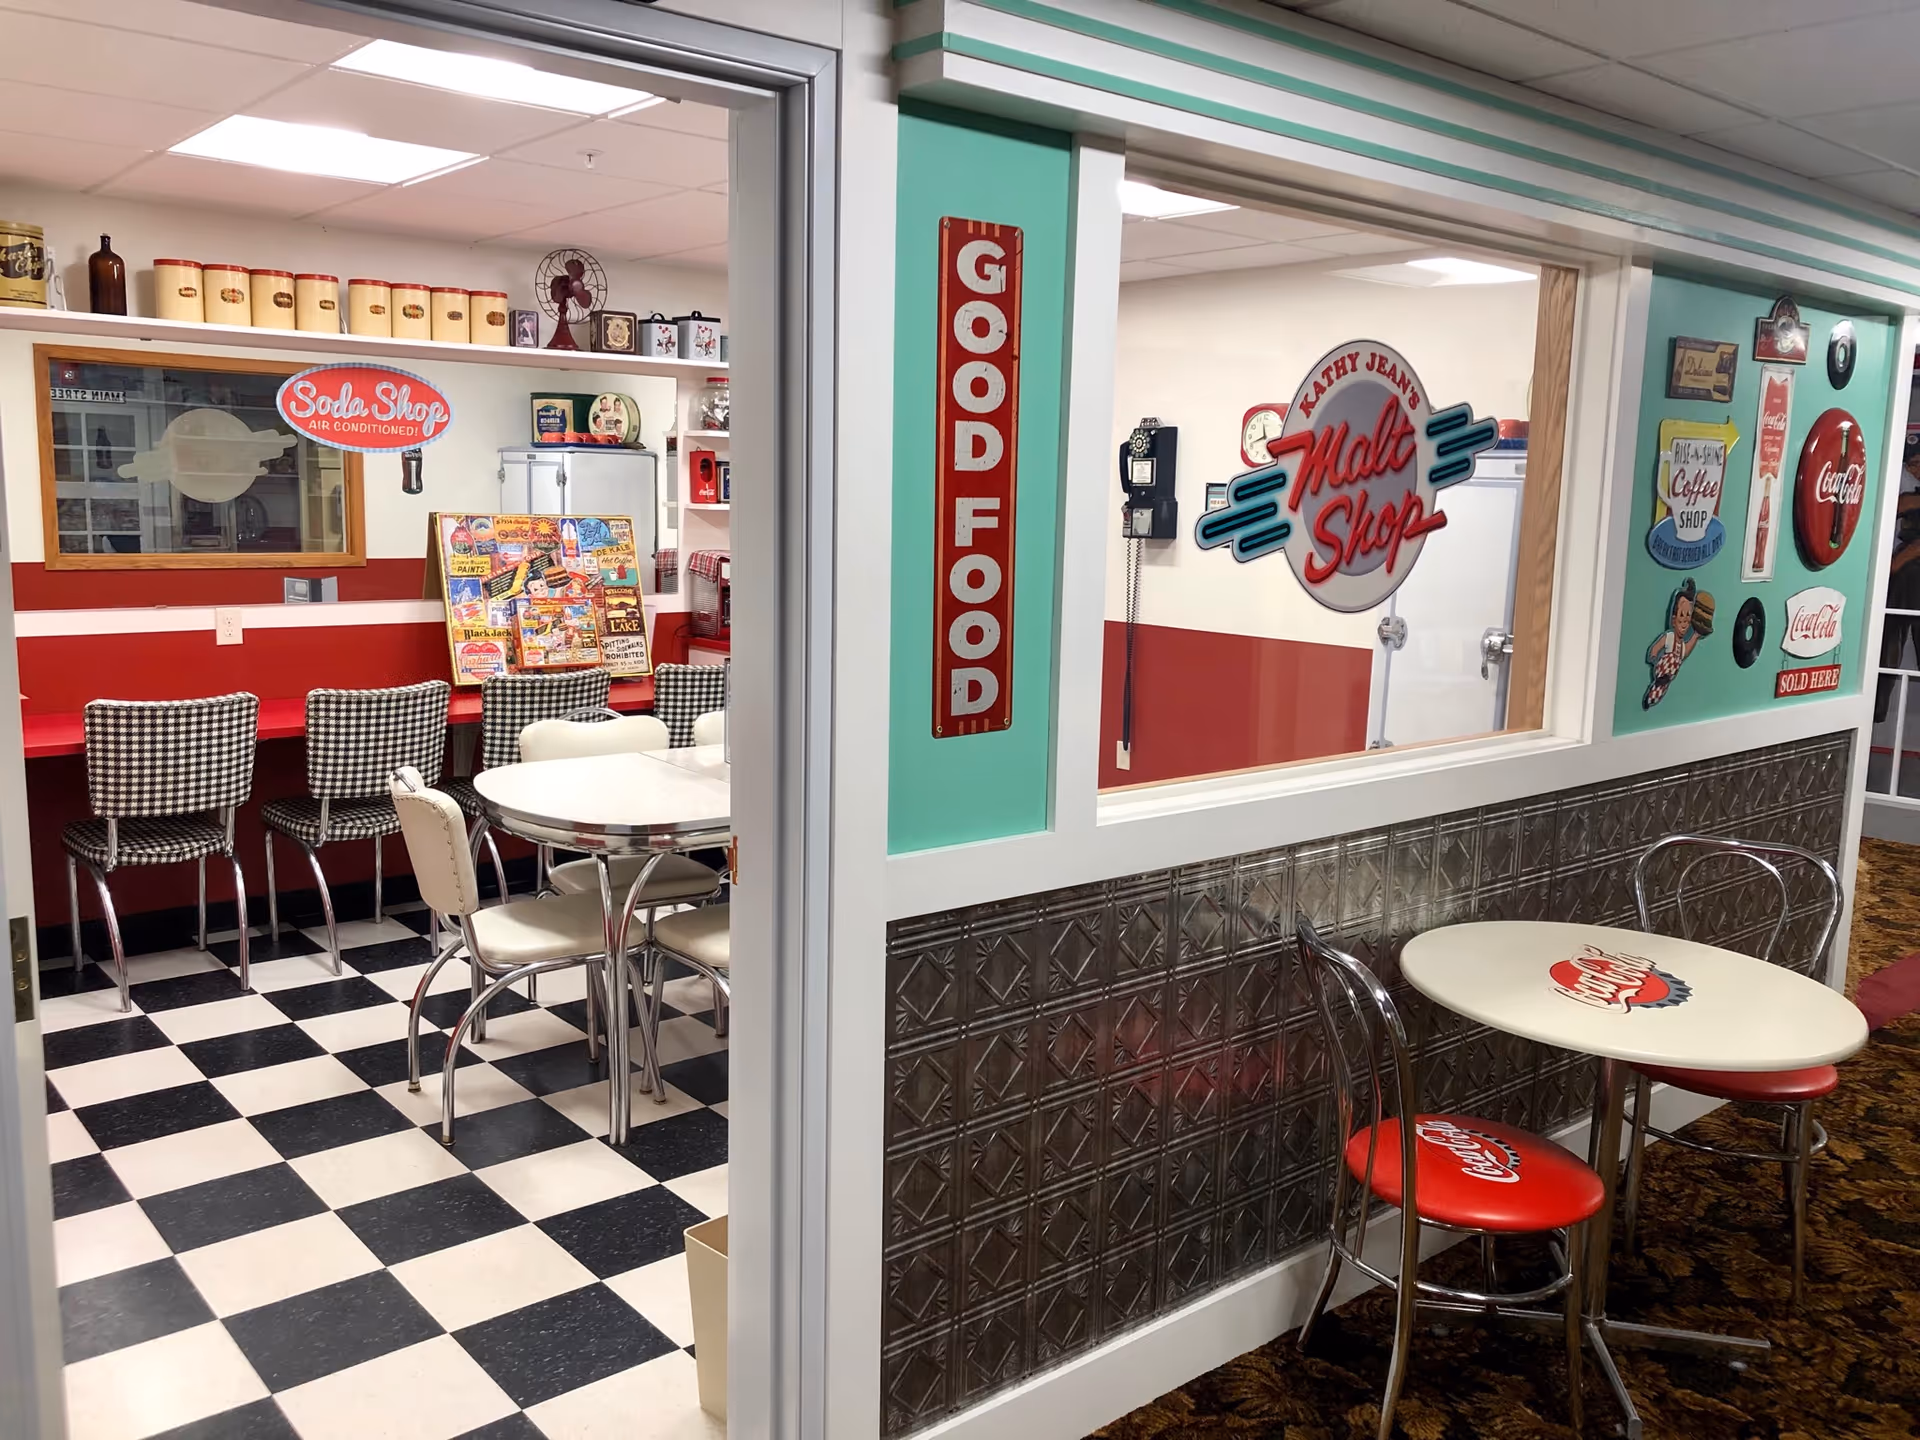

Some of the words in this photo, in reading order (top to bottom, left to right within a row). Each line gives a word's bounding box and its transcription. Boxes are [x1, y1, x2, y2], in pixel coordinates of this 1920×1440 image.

[0, 244, 37, 262] harles
[953, 239, 1008, 470] GOOD
[1299, 352, 1360, 419] KATHY
[1365, 352, 1420, 411] JEAN'S
[290, 380, 369, 419] Soda
[371, 381, 449, 437] Shop
[308, 420, 330, 430] AIR
[333, 423, 418, 437] CONDITIONED!
[1266, 393, 1416, 512] Malt
[1671, 467, 1719, 507] Coffee
[1679, 510, 1708, 529] SHOP
[1304, 489, 1448, 584] Shop
[457, 565, 486, 574] PAINTS
[949, 497, 1002, 717] FOOD
[463, 629, 491, 640] Black
[491, 629, 512, 638] Jack
[611, 618, 640, 633] LAKE
[1780, 672, 1808, 693] SOLD
[1809, 668, 1840, 689] HERE
